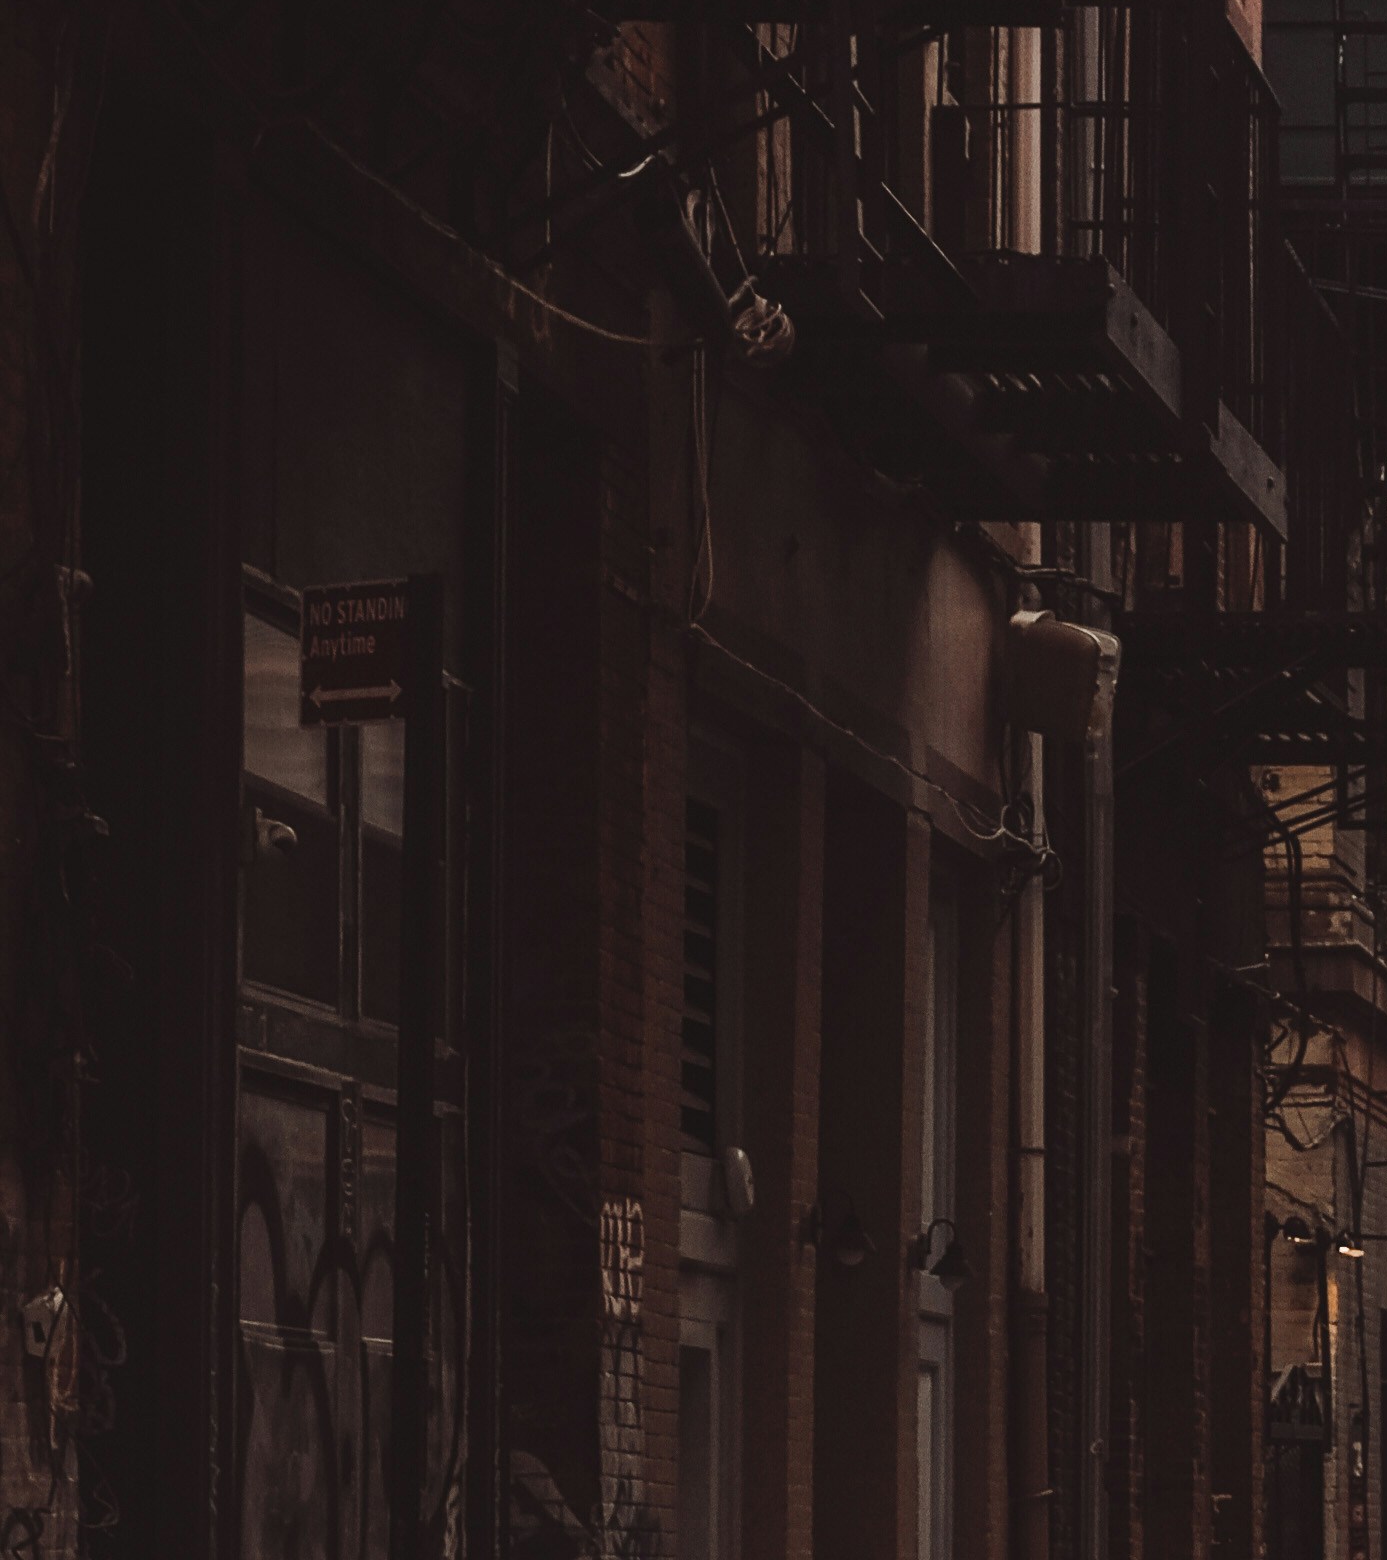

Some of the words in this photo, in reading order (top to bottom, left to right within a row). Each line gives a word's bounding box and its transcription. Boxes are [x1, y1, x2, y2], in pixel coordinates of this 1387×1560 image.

[310, 601, 332, 626] NO
[337, 597, 405, 624] STANDIN
[310, 631, 376, 662] Anytime
